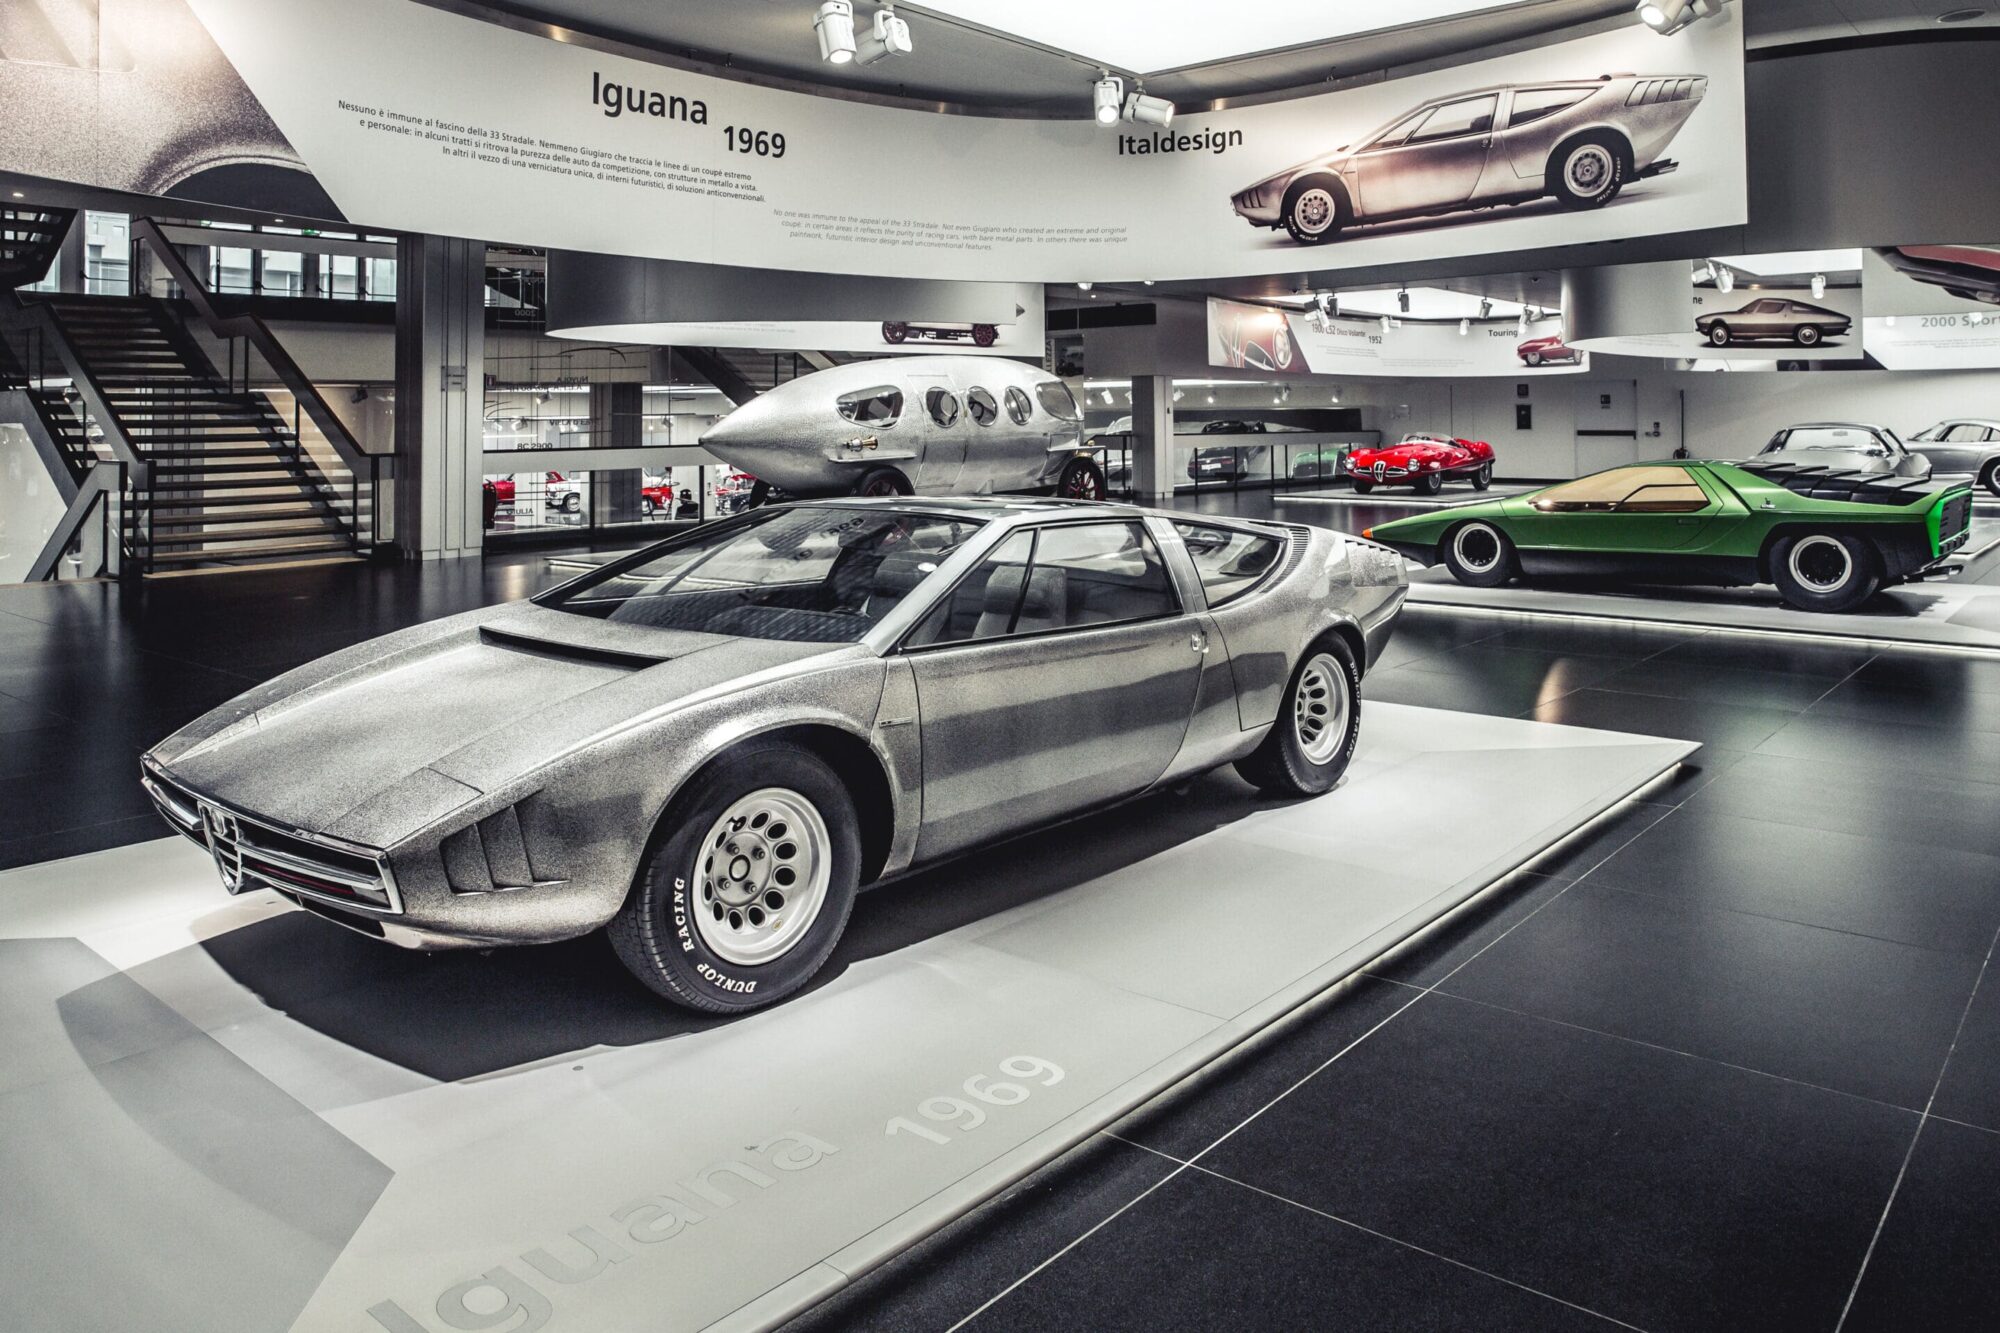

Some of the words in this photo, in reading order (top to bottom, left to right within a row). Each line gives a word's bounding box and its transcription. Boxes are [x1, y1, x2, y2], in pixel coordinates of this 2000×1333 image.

[592, 72, 707, 125] Iguana
[338, 100, 376, 116] Nessuno
[379, 108, 384, 117] è
[387, 110, 422, 124] immune
[425, 118, 432, 126] al
[436, 120, 464, 132] fascino
[467, 126, 488, 138] della
[490, 130, 500, 140] 33
[502, 133, 536, 146] Stradale.
[540, 140, 578, 154] Nemmeno
[580, 147, 612, 159] Giugiaro
[614, 153, 626, 162] che
[629, 156, 652, 166] traccia
[664, 160, 680, 170] linee
[724, 171, 752, 180] estremo
[368, 120, 412, 136] personale:
[414, 128, 422, 137] in
[425, 131, 450, 142] alcuni
[452, 136, 472, 146] tratti
[474, 138, 480, 148] si
[483, 141, 508, 152] ritrova
[512, 146, 518, 154] la
[520, 149, 550, 160] purezza
[552, 154, 570, 164] delle
[572, 158, 589, 166] auto
[592, 160, 600, 168] da
[602, 162, 652, 178] competizione,
[668, 172, 698, 184] strutture
[700, 176, 706, 184] in
[708, 178, 733, 188] metallo
[724, 126, 786, 158] 1969
[1118, 128, 1242, 154] Italdesign
[442, 146, 450, 155] In
[452, 148, 468, 158] altri
[471, 151, 476, 159] il
[478, 153, 500, 163] vezzo
[502, 156, 510, 164] di
[512, 159, 526, 168] una
[528, 162, 572, 175] verniciatura
[574, 169, 594, 180] unica,
[597, 172, 604, 180] di
[606, 174, 629, 184] interni
[631, 178, 665, 190] futuristici,
[676, 184, 704, 194] soluzioni
[826, 233, 852, 242] futuristic
[880, 238, 900, 246] design
[915, 240, 964, 248] unconventional
[972, 225, 1000, 233] Giugiaro
[1100, 226, 1127, 234] original
[1488, 329, 1518, 338] Touring
[1921, 316, 1956, 328] 2000
[1368, 336, 1382, 344] 1952
[674, 878, 694, 952] RACING
[697, 963, 757, 993] DUNLOP
[884, 1054, 1066, 1146] 1969
